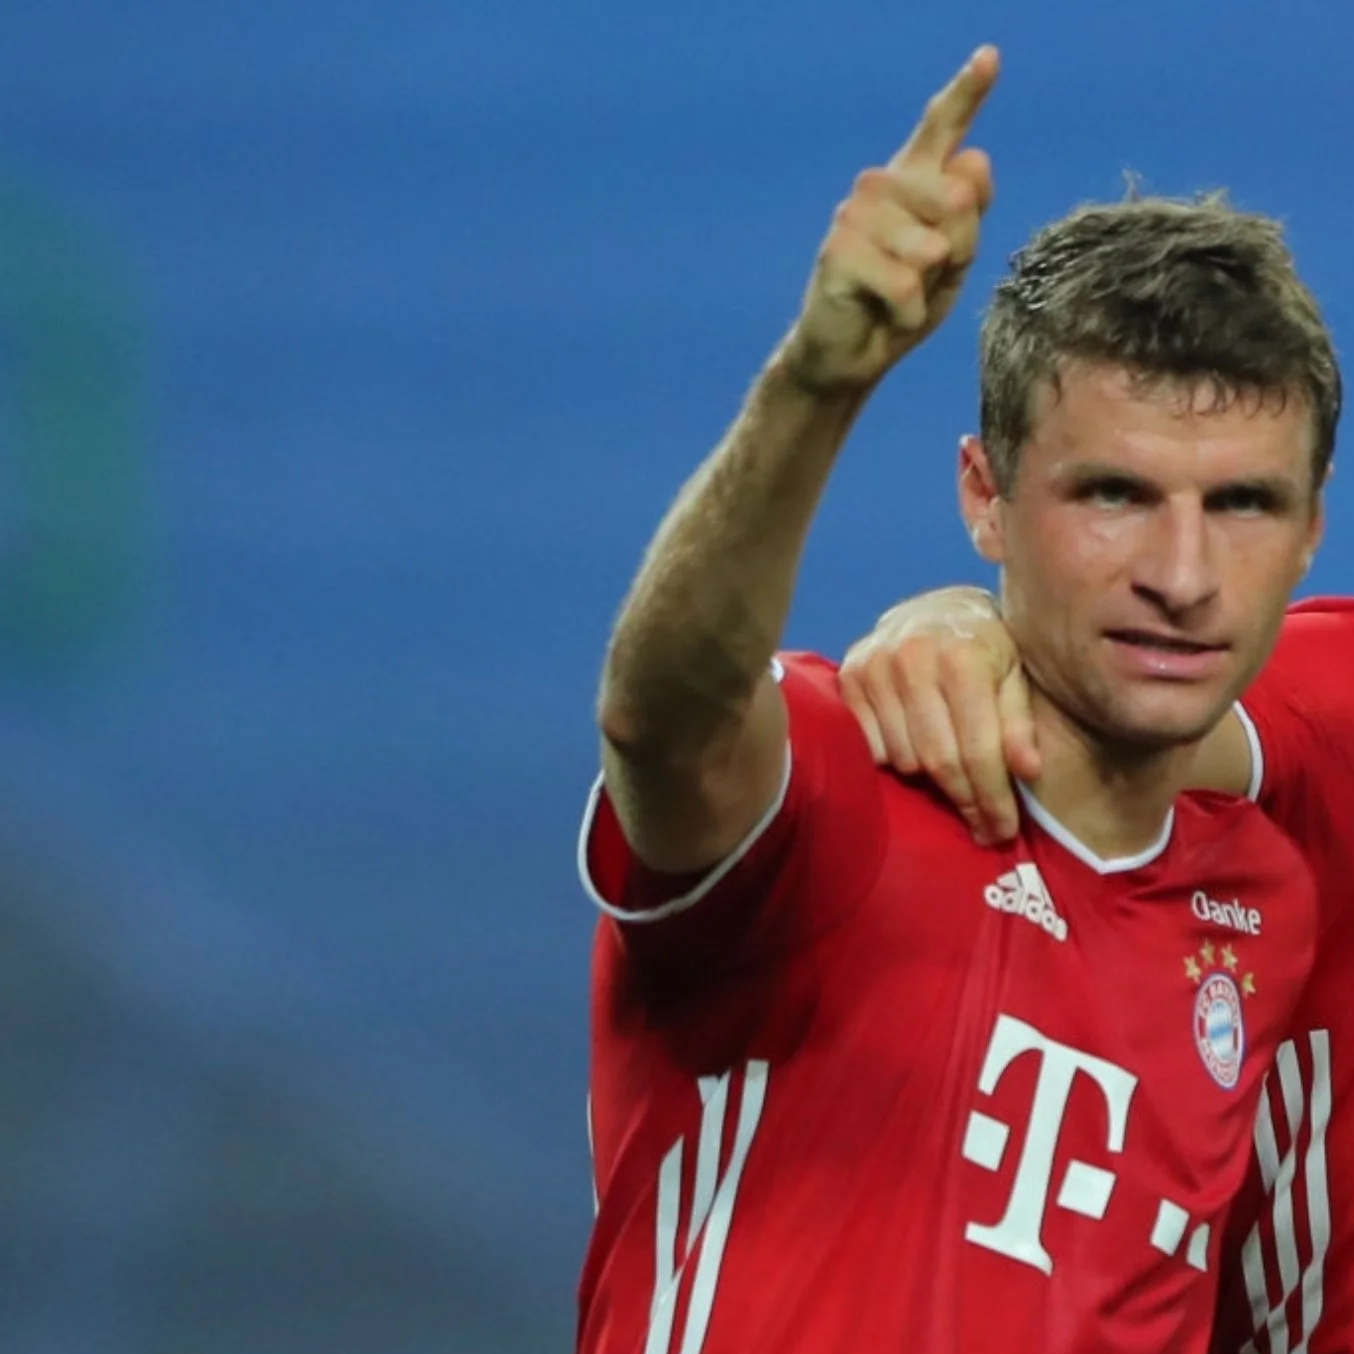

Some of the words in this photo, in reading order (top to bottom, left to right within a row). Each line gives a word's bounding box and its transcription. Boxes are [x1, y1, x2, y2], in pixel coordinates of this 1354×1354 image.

[984, 883, 1068, 942] adidas
[1191, 890, 1263, 936] Danke
[963, 1014, 1139, 1276] T
